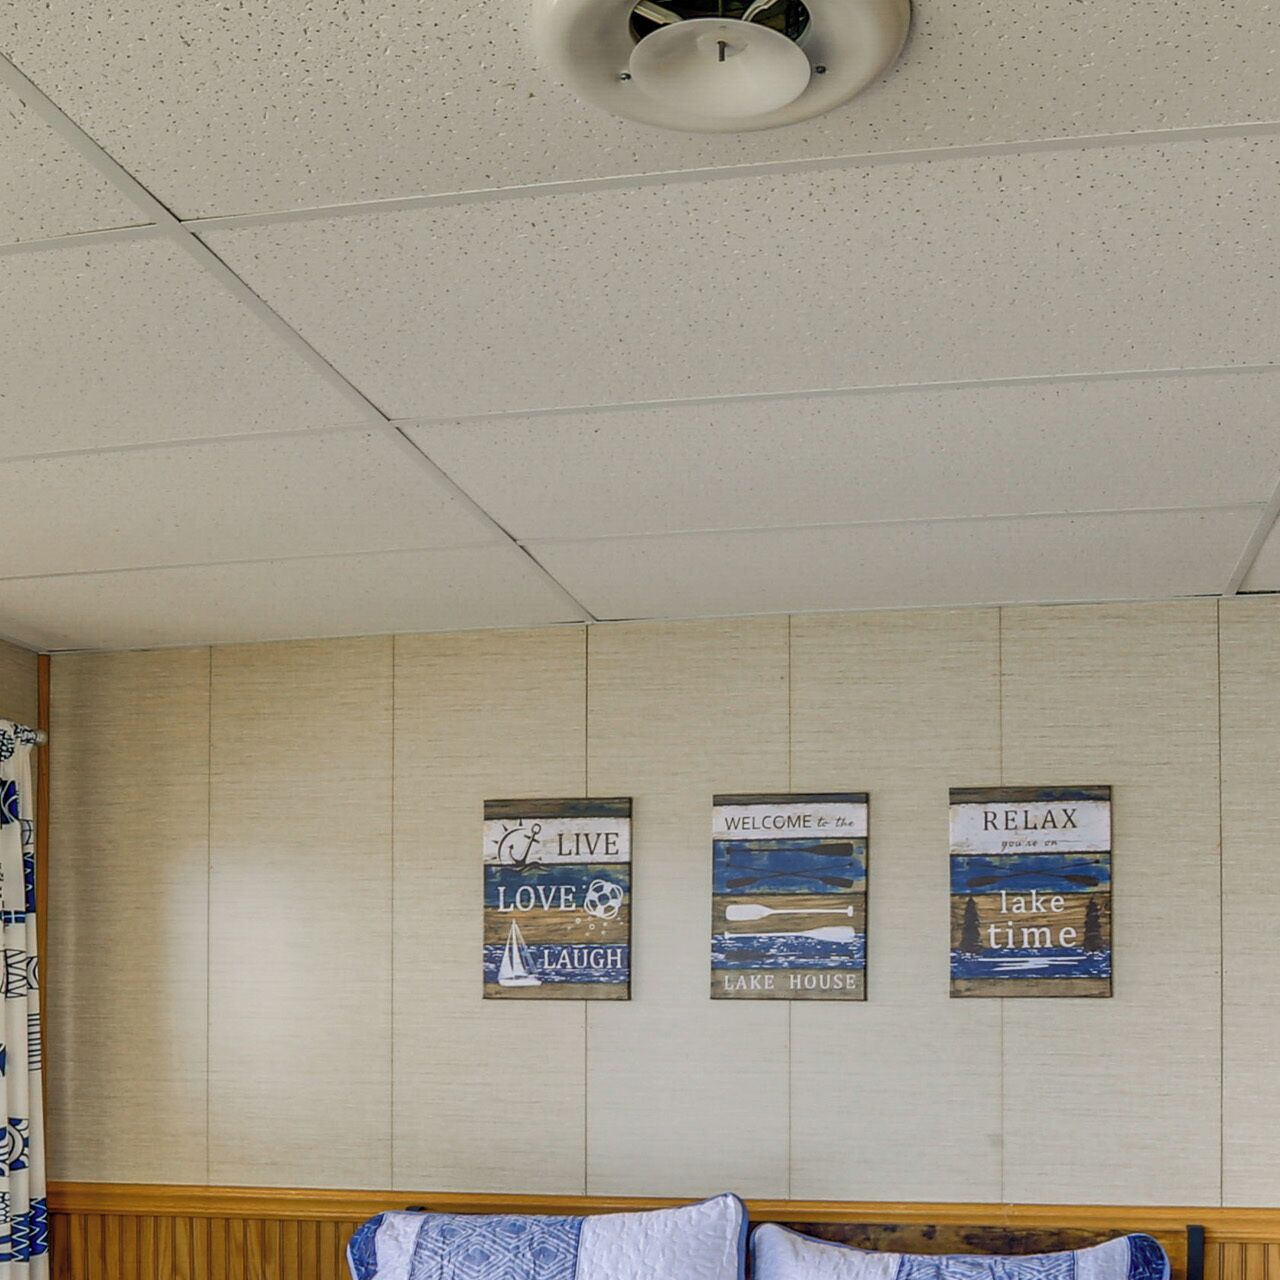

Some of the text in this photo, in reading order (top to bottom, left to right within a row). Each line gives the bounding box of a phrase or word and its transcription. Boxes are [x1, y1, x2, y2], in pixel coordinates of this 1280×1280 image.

[724, 814, 856, 831] WELCOME to the
[982, 808, 1078, 832] RELAX
[557, 832, 620, 857] LIVE
[1043, 839, 1059, 848] on
[496, 885, 578, 913] LOVE
[999, 889, 1066, 915] lake
[986, 920, 1078, 950] time
[543, 947, 623, 970] LAUGH
[723, 973, 857, 991] LAKE HOUSE
